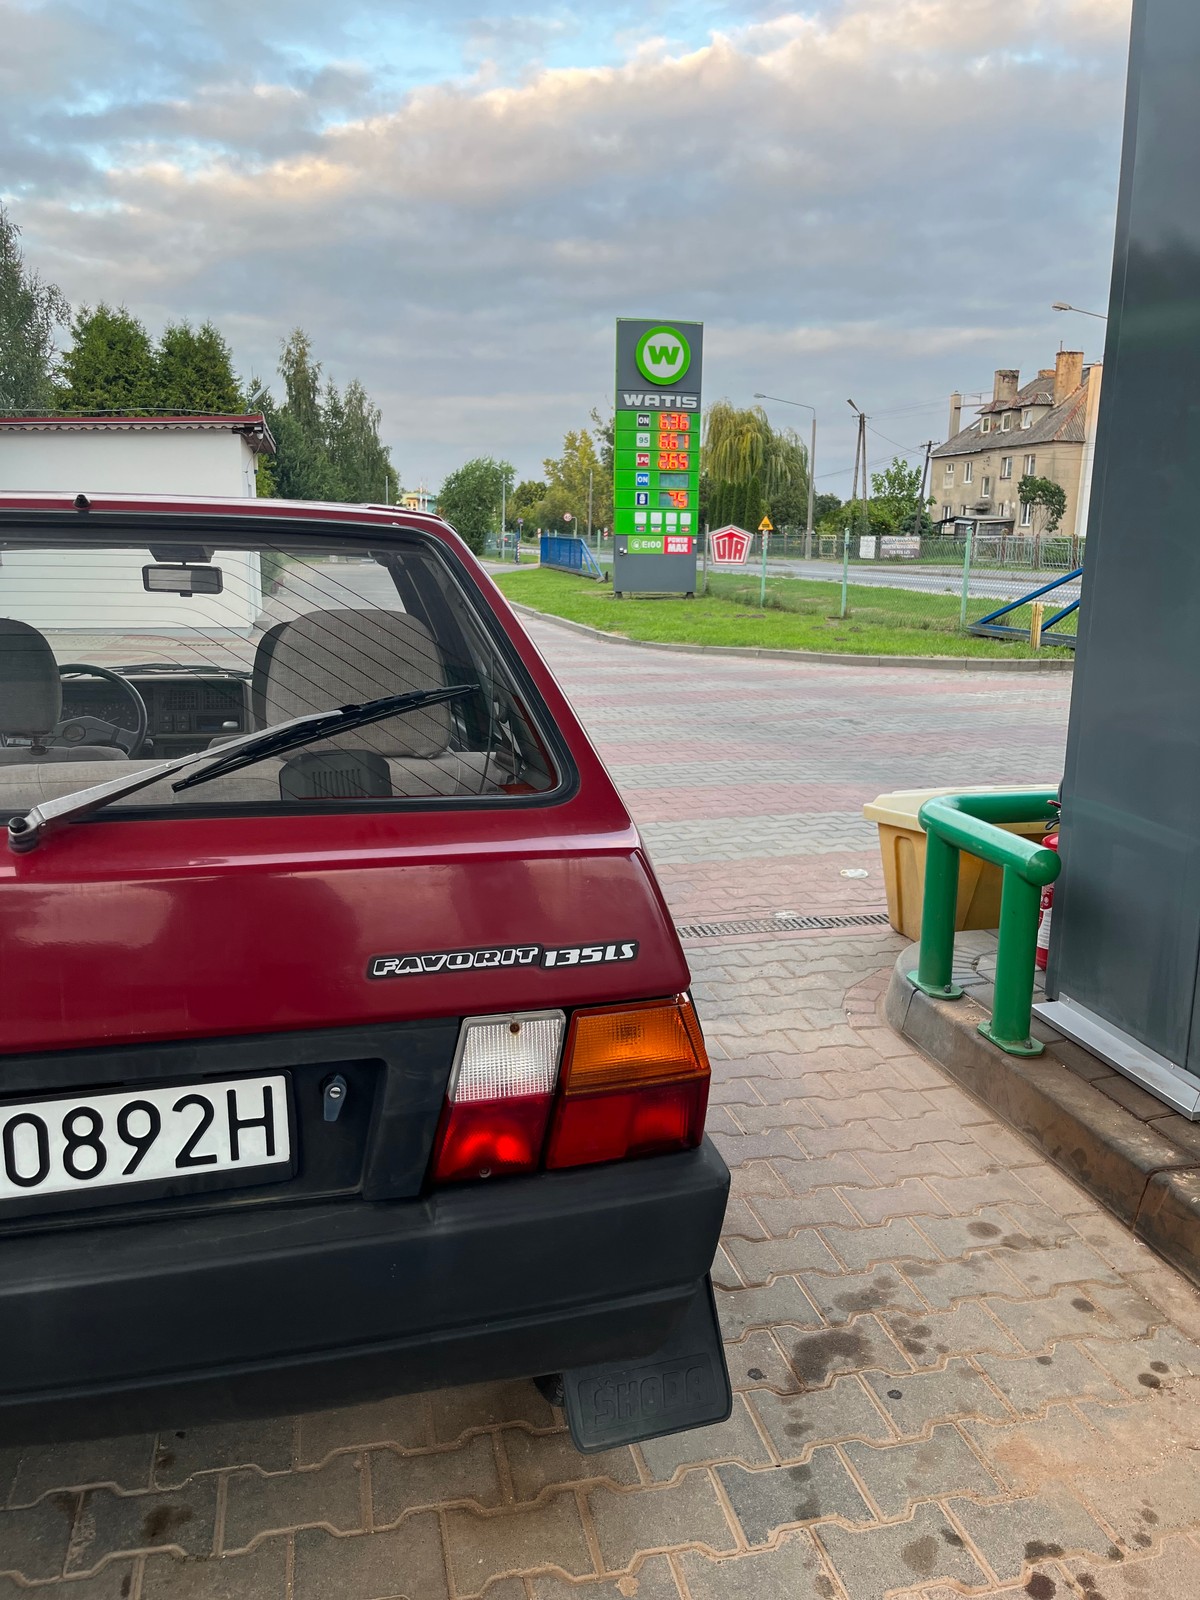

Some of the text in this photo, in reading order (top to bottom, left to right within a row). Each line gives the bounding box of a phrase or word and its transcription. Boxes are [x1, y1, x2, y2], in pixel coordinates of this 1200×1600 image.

[648, 345, 680, 365] W
[623, 394, 697, 409] WATIS
[638, 416, 649, 424] ON
[638, 436, 649, 444] 95
[637, 475, 648, 483] ON
[642, 540, 662, 549] E100
[667, 543, 689, 553] MAX
[715, 529, 747, 560] UTA
[373, 943, 636, 976] FAVORIT 135LS
[2, 1085, 276, 1187] 0892H
